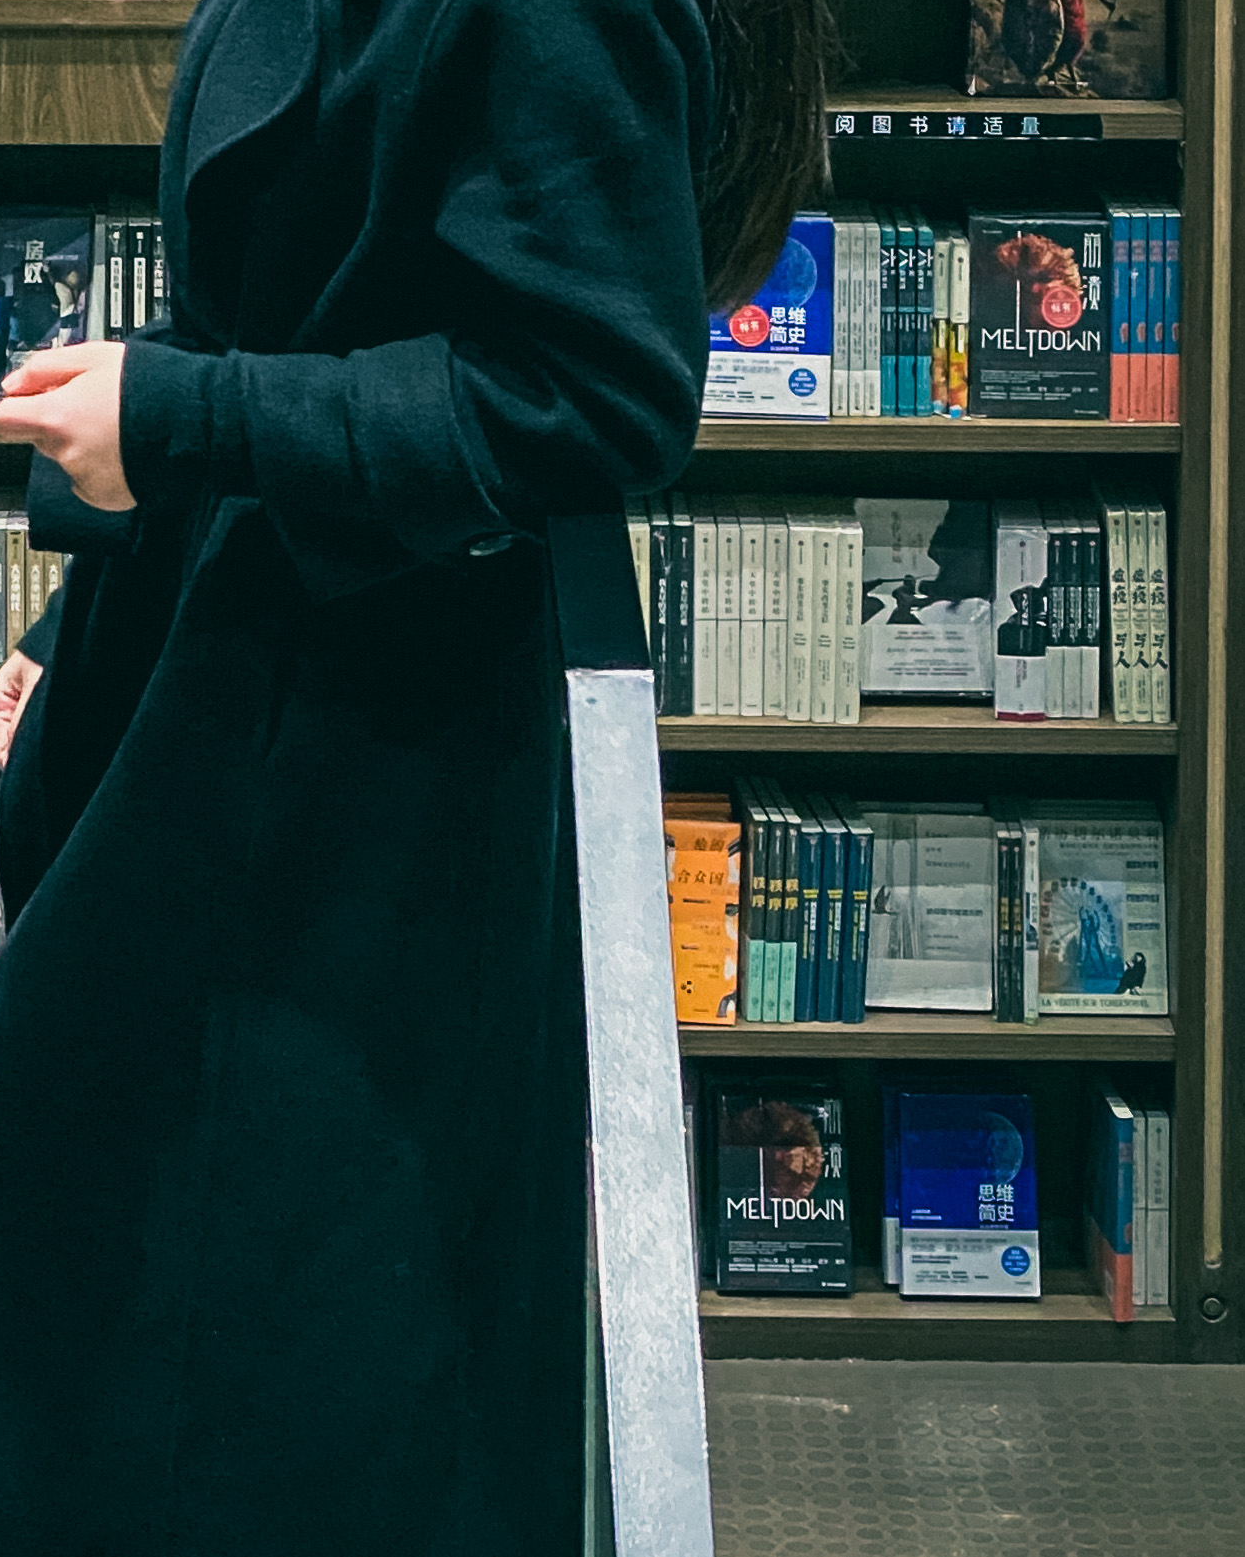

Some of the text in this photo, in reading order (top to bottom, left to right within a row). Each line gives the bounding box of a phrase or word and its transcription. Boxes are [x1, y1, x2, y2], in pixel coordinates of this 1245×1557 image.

[834, 115, 1042, 136] 阅图书请适量
[23, 239, 45, 284] 房奴
[769, 306, 807, 325] 思维
[769, 326, 806, 344] 简史
[981, 328, 1102, 358] MELTDOWN
[978, 1183, 1015, 1203] 思维
[726, 1197, 845, 1229] MELTDOWN
[978, 1204, 1015, 1222] 简史
